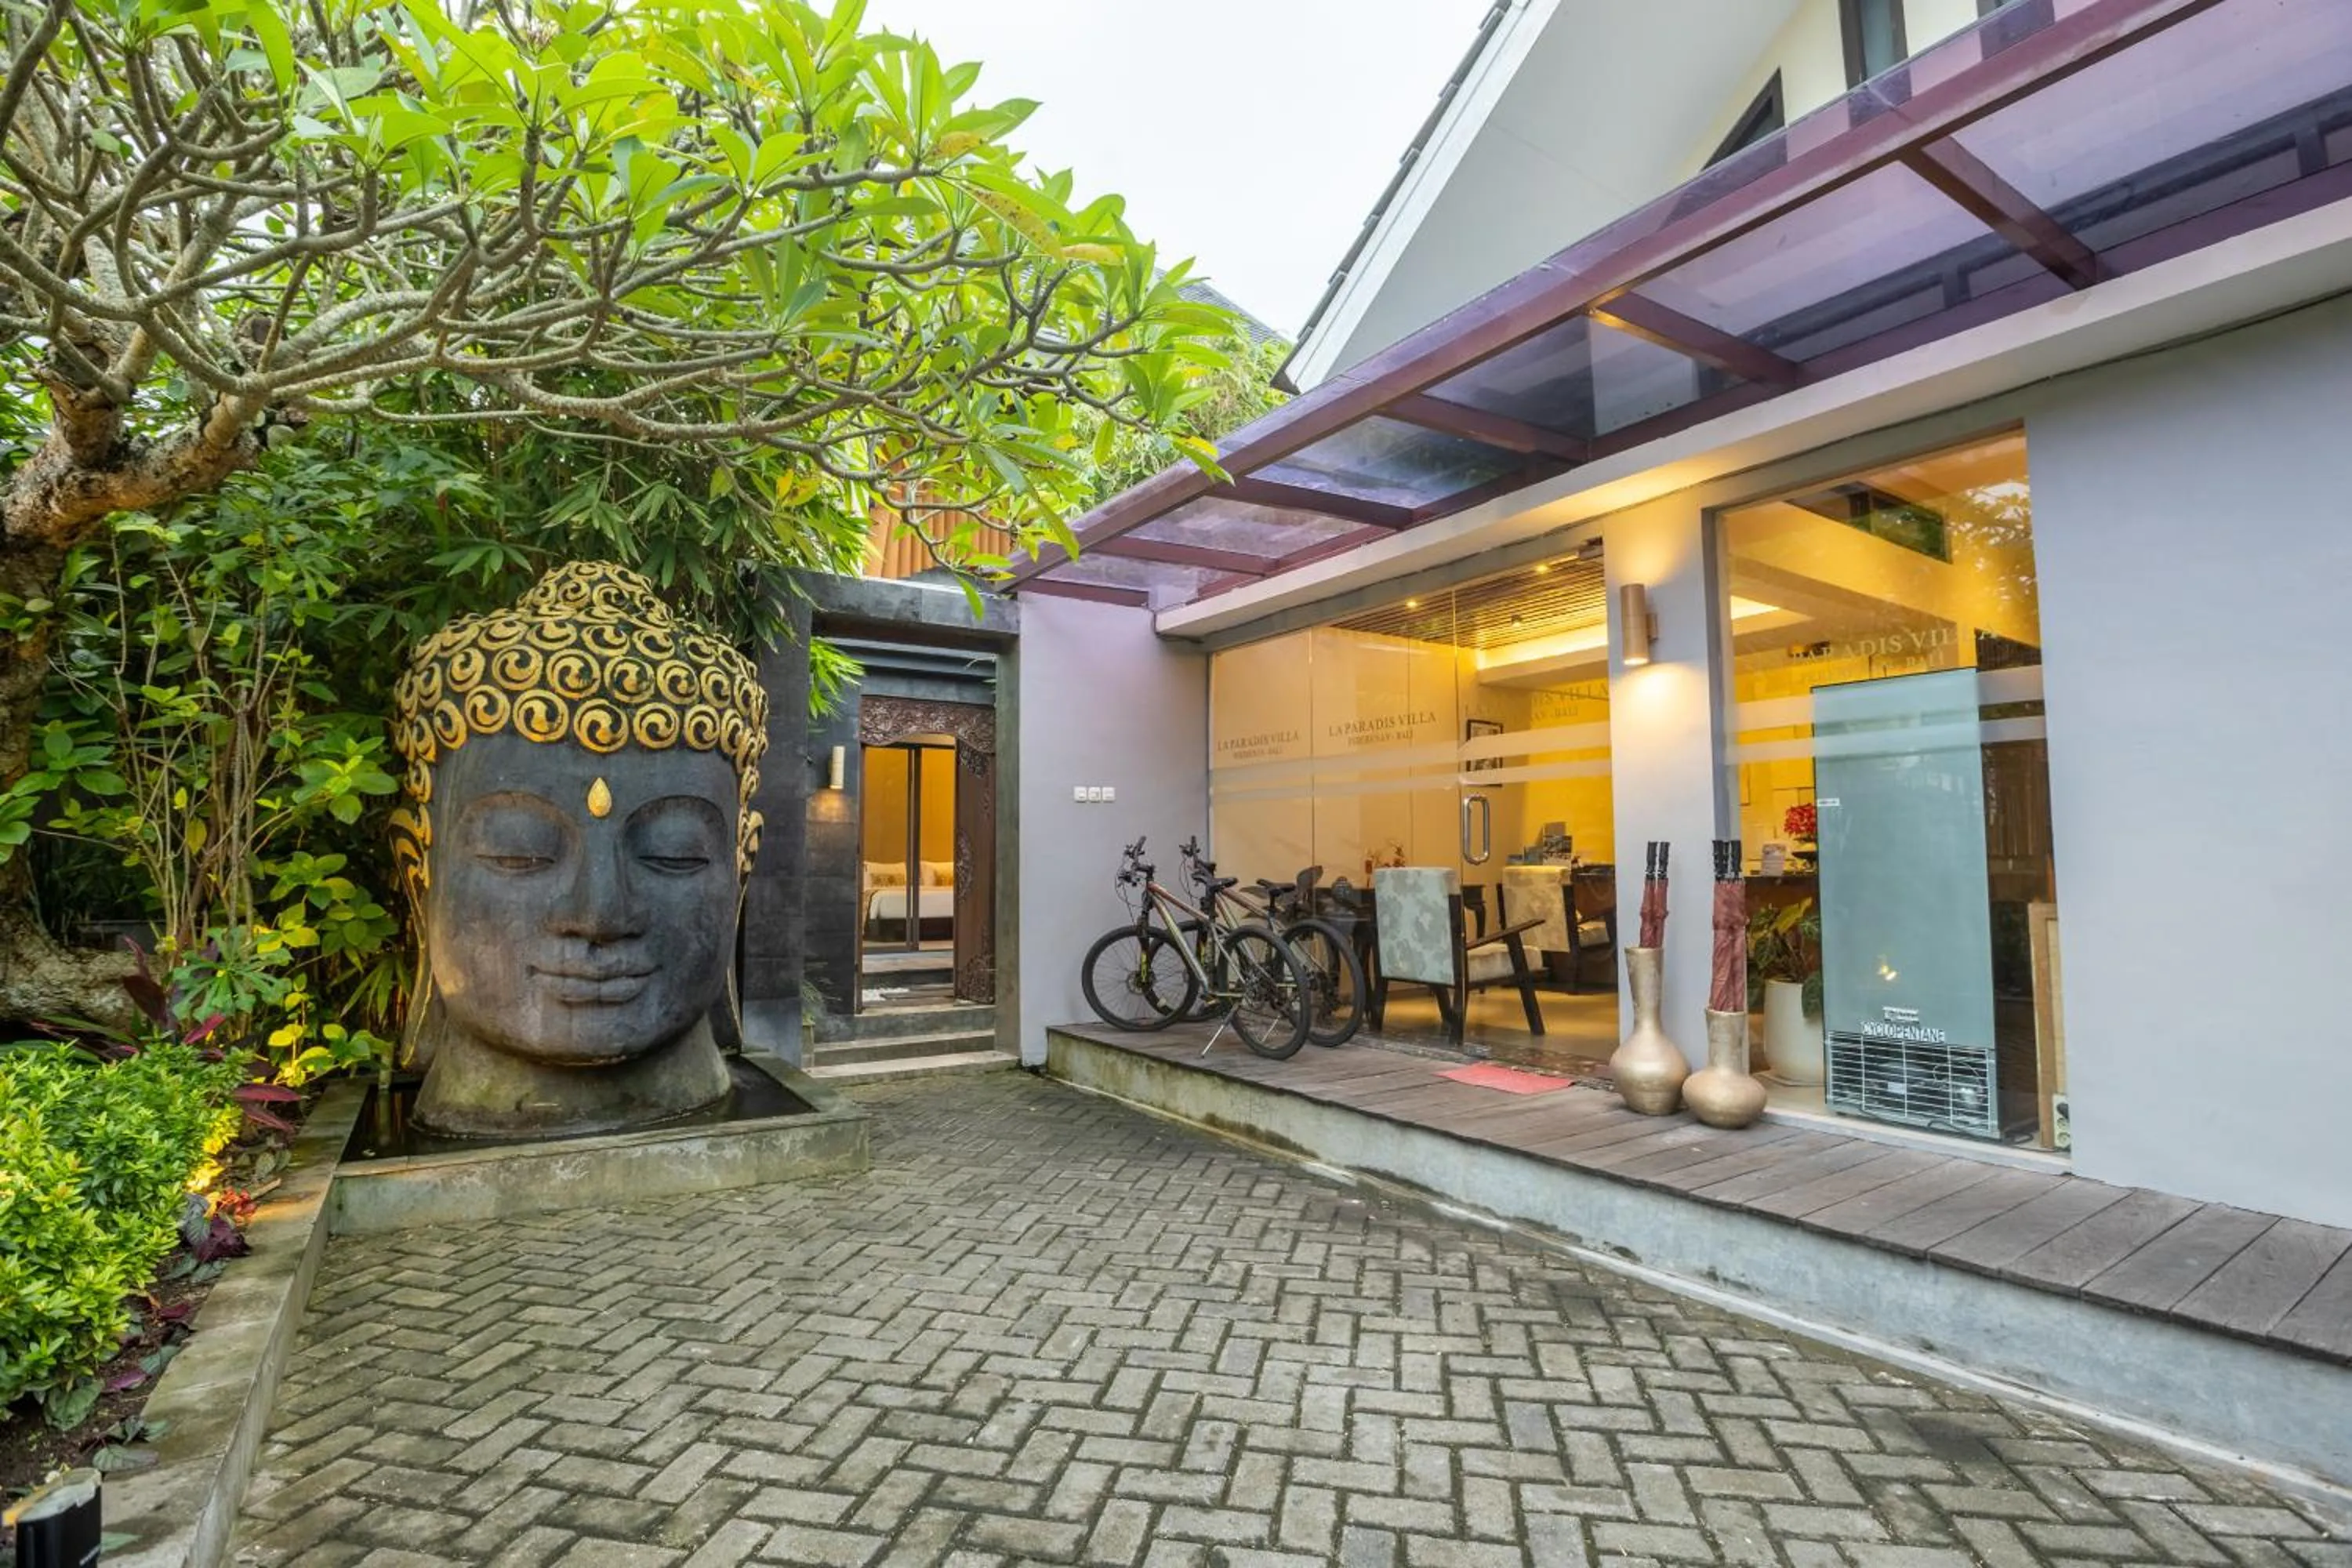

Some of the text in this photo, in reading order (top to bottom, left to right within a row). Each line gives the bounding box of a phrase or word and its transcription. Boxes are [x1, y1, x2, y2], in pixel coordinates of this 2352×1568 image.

[1328, 710, 1437, 737] LA PARADIS VILLA
[1217, 729, 1299, 752] LA PARADIS VILLA
[1860, 1021, 1945, 1043] CYCLOPENTANE
